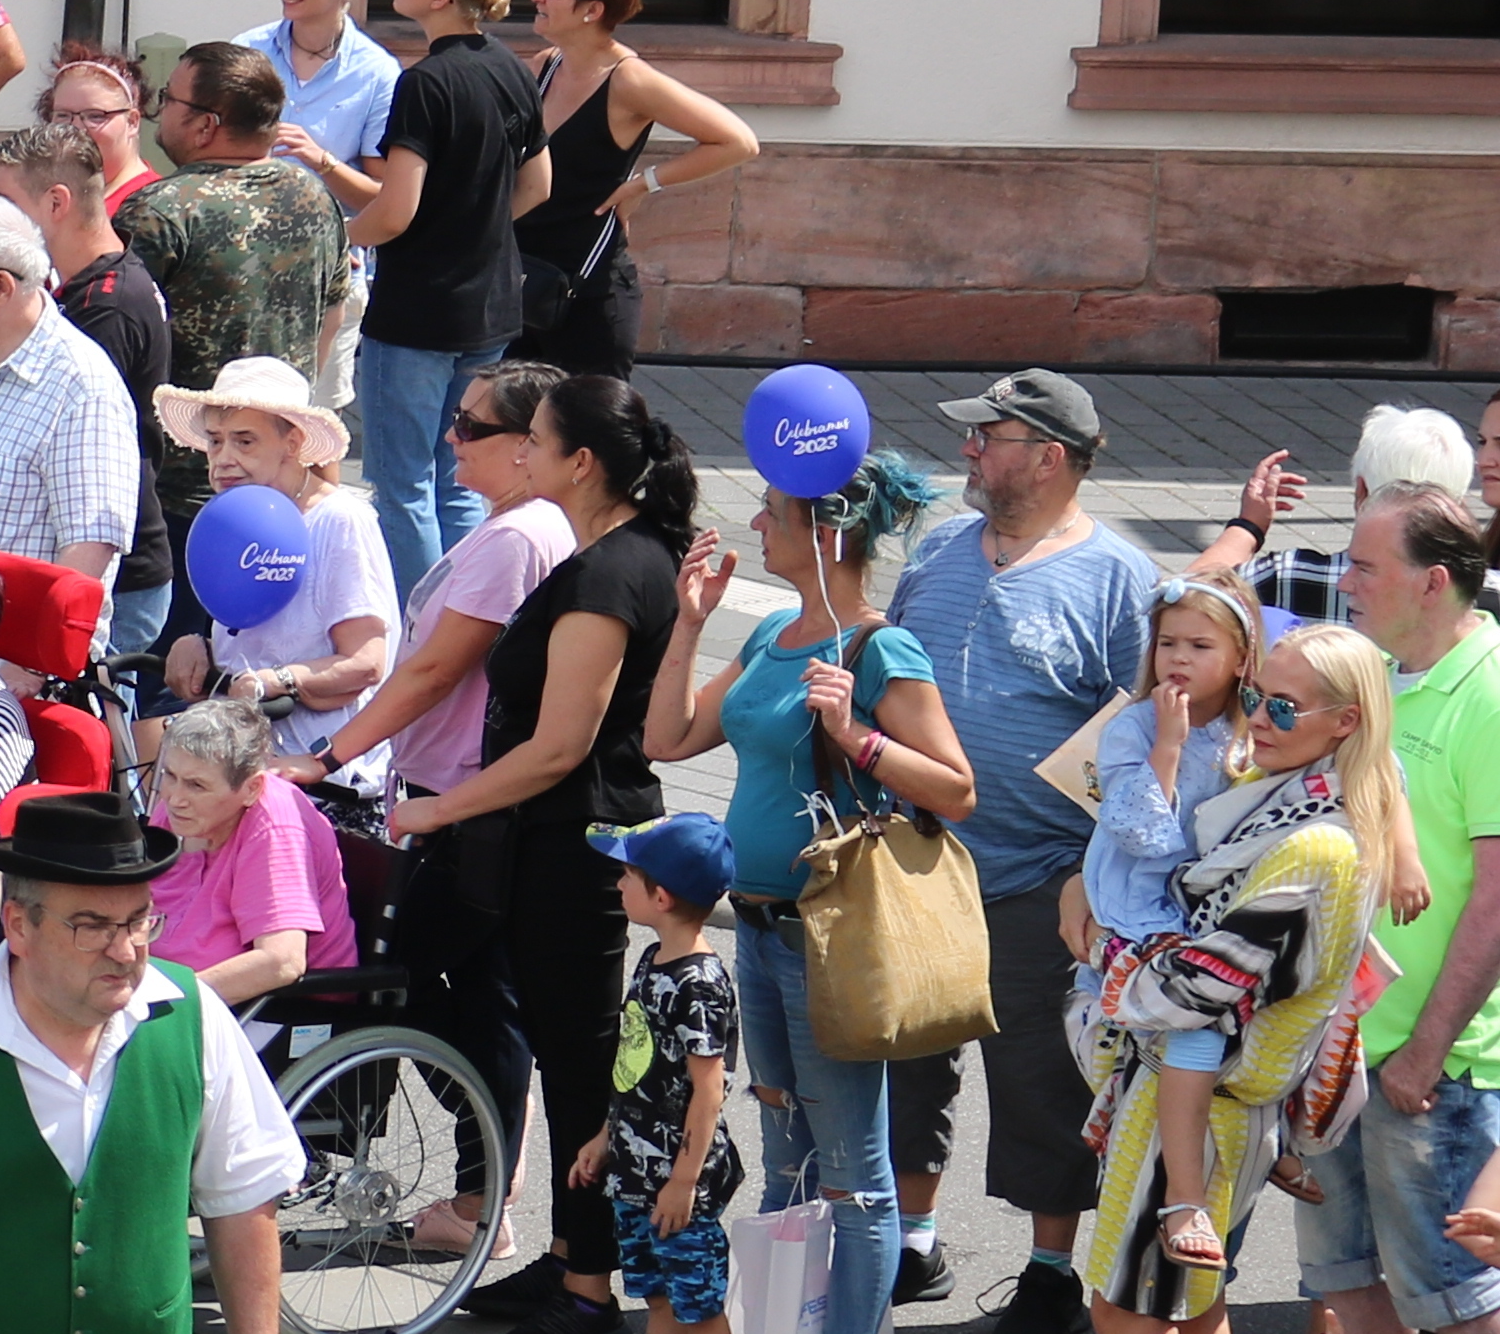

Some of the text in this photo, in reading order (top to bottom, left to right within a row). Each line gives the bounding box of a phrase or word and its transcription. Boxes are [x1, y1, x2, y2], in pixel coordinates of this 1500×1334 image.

[775, 418, 850, 447] Celebramus
[793, 434, 839, 456] 2023
[240, 542, 307, 569] Celebramus
[255, 566, 296, 582] 2023
